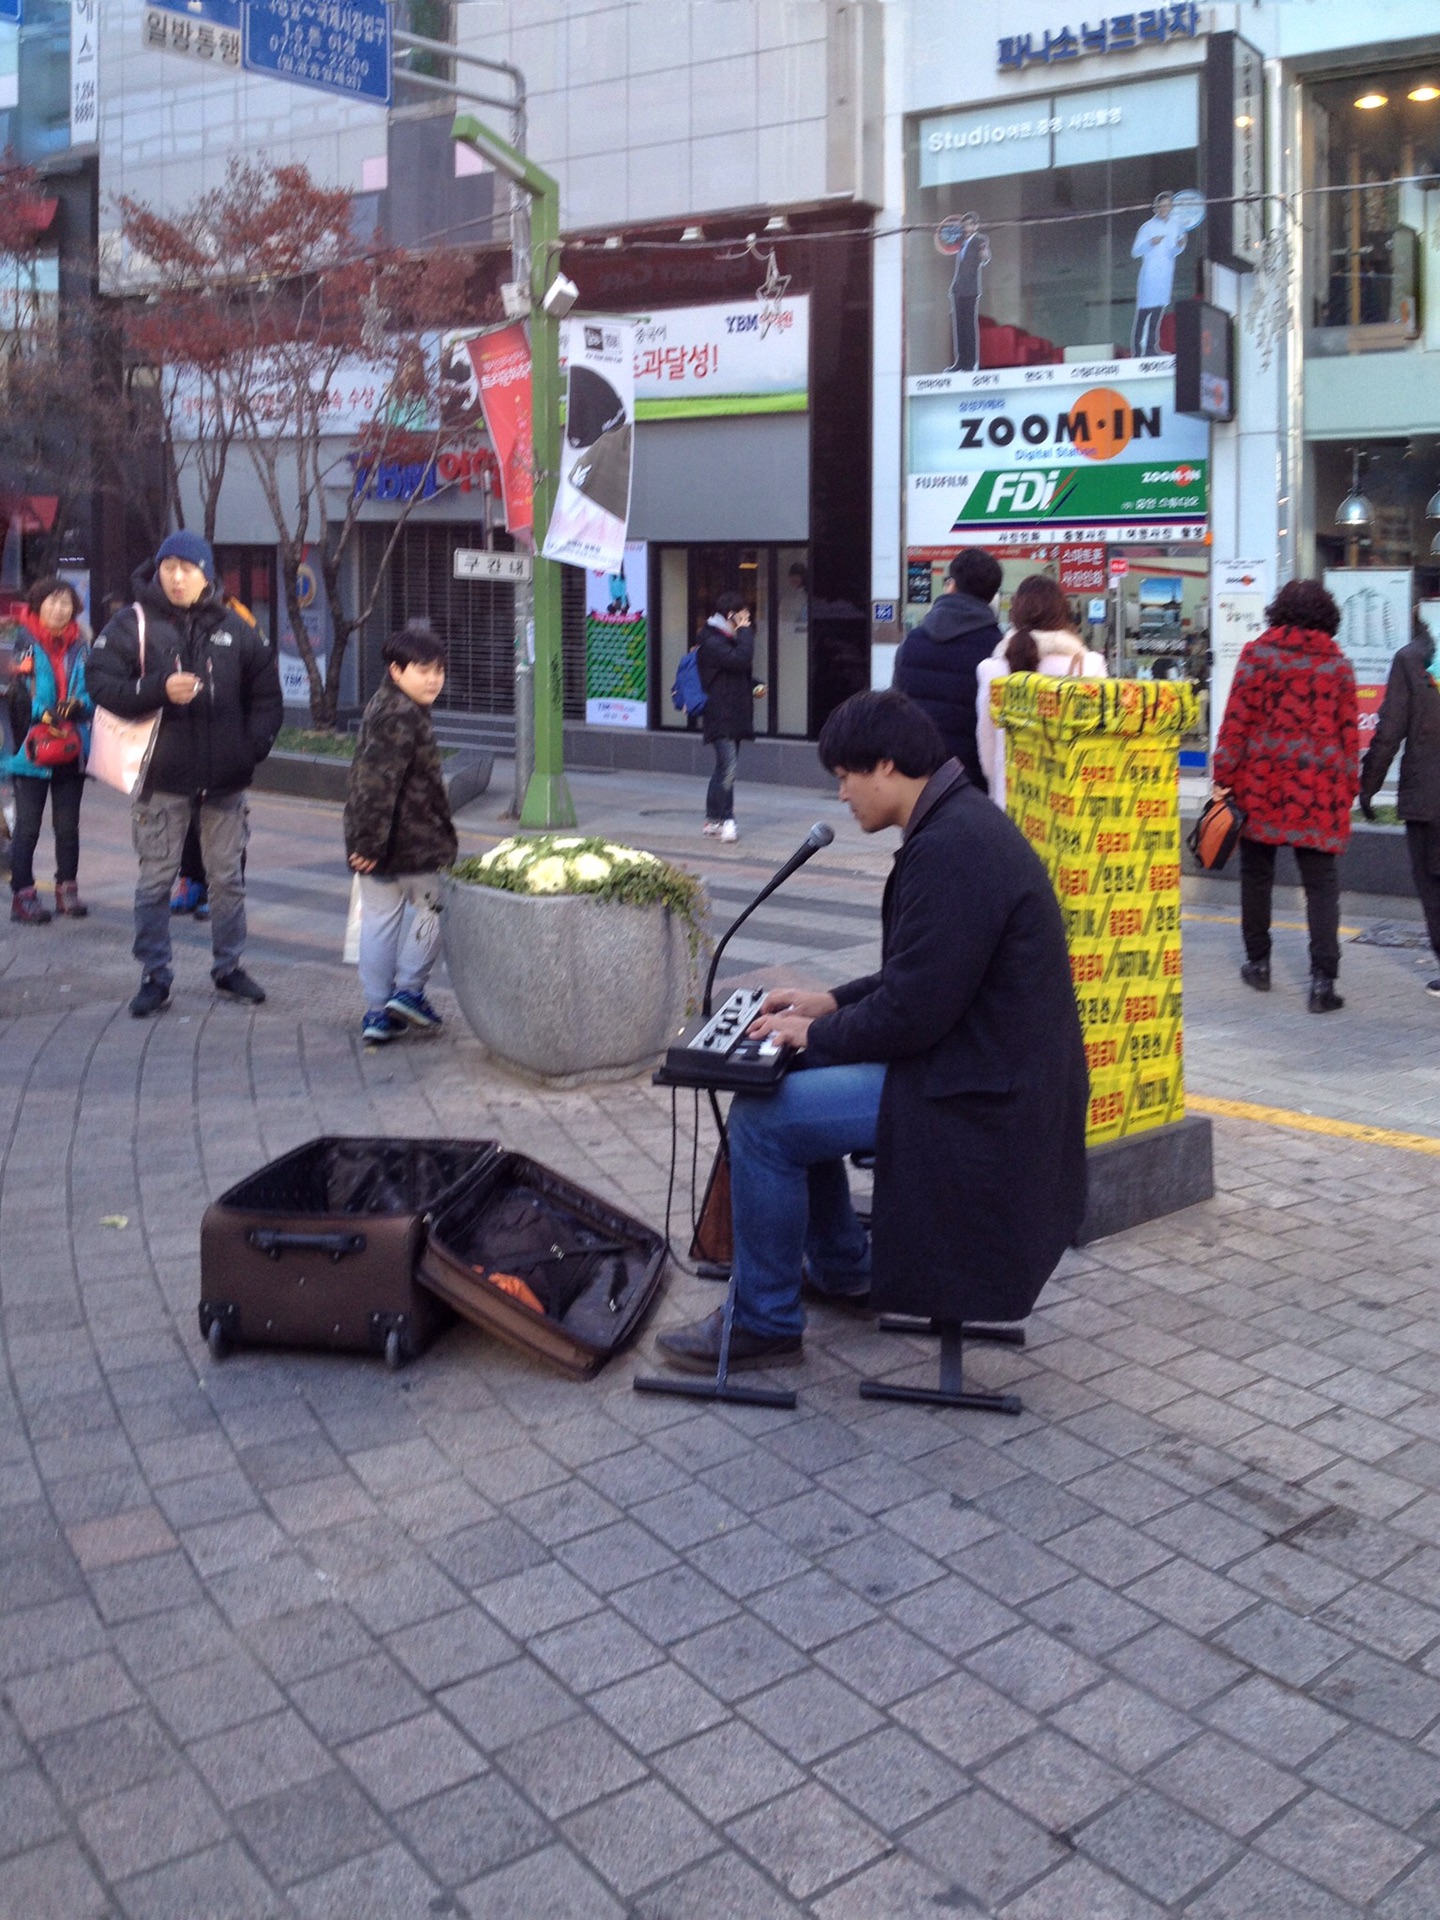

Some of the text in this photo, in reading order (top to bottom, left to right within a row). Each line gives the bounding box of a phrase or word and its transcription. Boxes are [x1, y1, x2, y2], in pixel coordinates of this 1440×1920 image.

[147, 12, 240, 67] 일방통행
[997, 2, 1200, 69] 파나소닉프라자
[928, 123, 1006, 153] Studio
[1015, 449, 1053, 461] Digital
[915, 475, 969, 489] FUJIFILM
